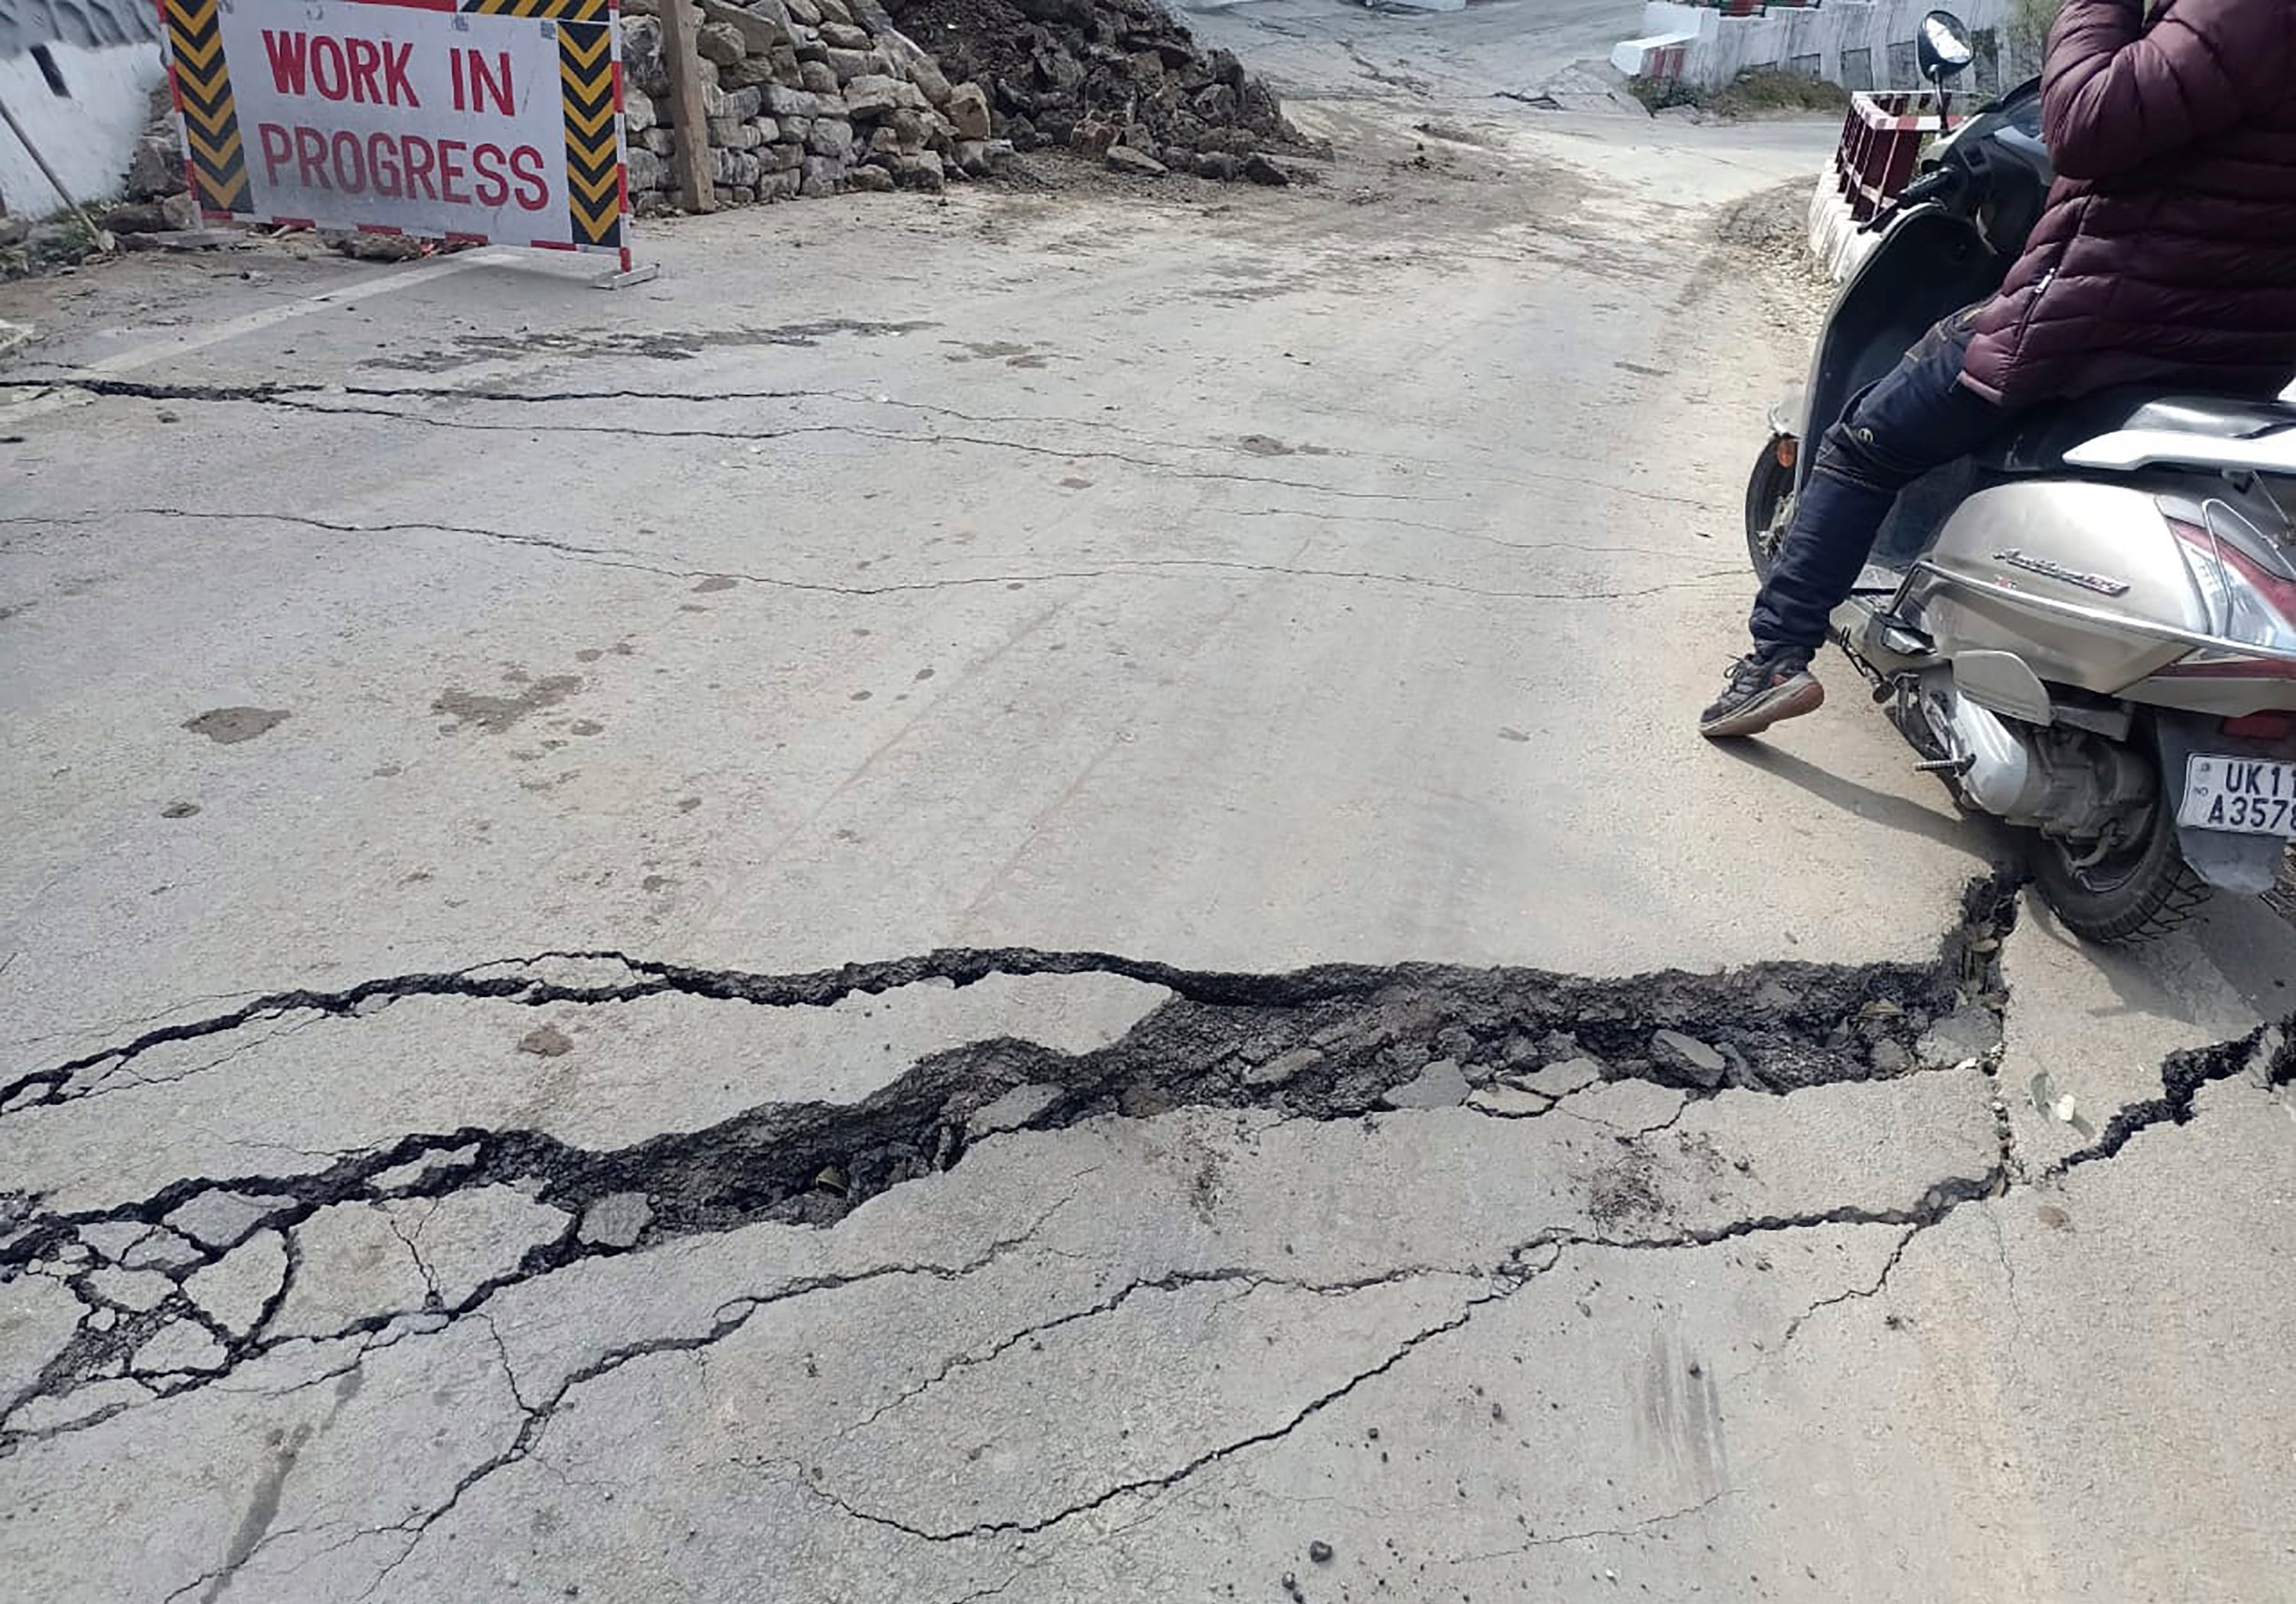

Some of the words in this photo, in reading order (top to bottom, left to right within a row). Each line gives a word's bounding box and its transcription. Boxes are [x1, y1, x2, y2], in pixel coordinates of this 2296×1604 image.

[261, 29, 420, 107] WORK
[449, 47, 516, 116] IN
[258, 123, 550, 211] PROGRESS
